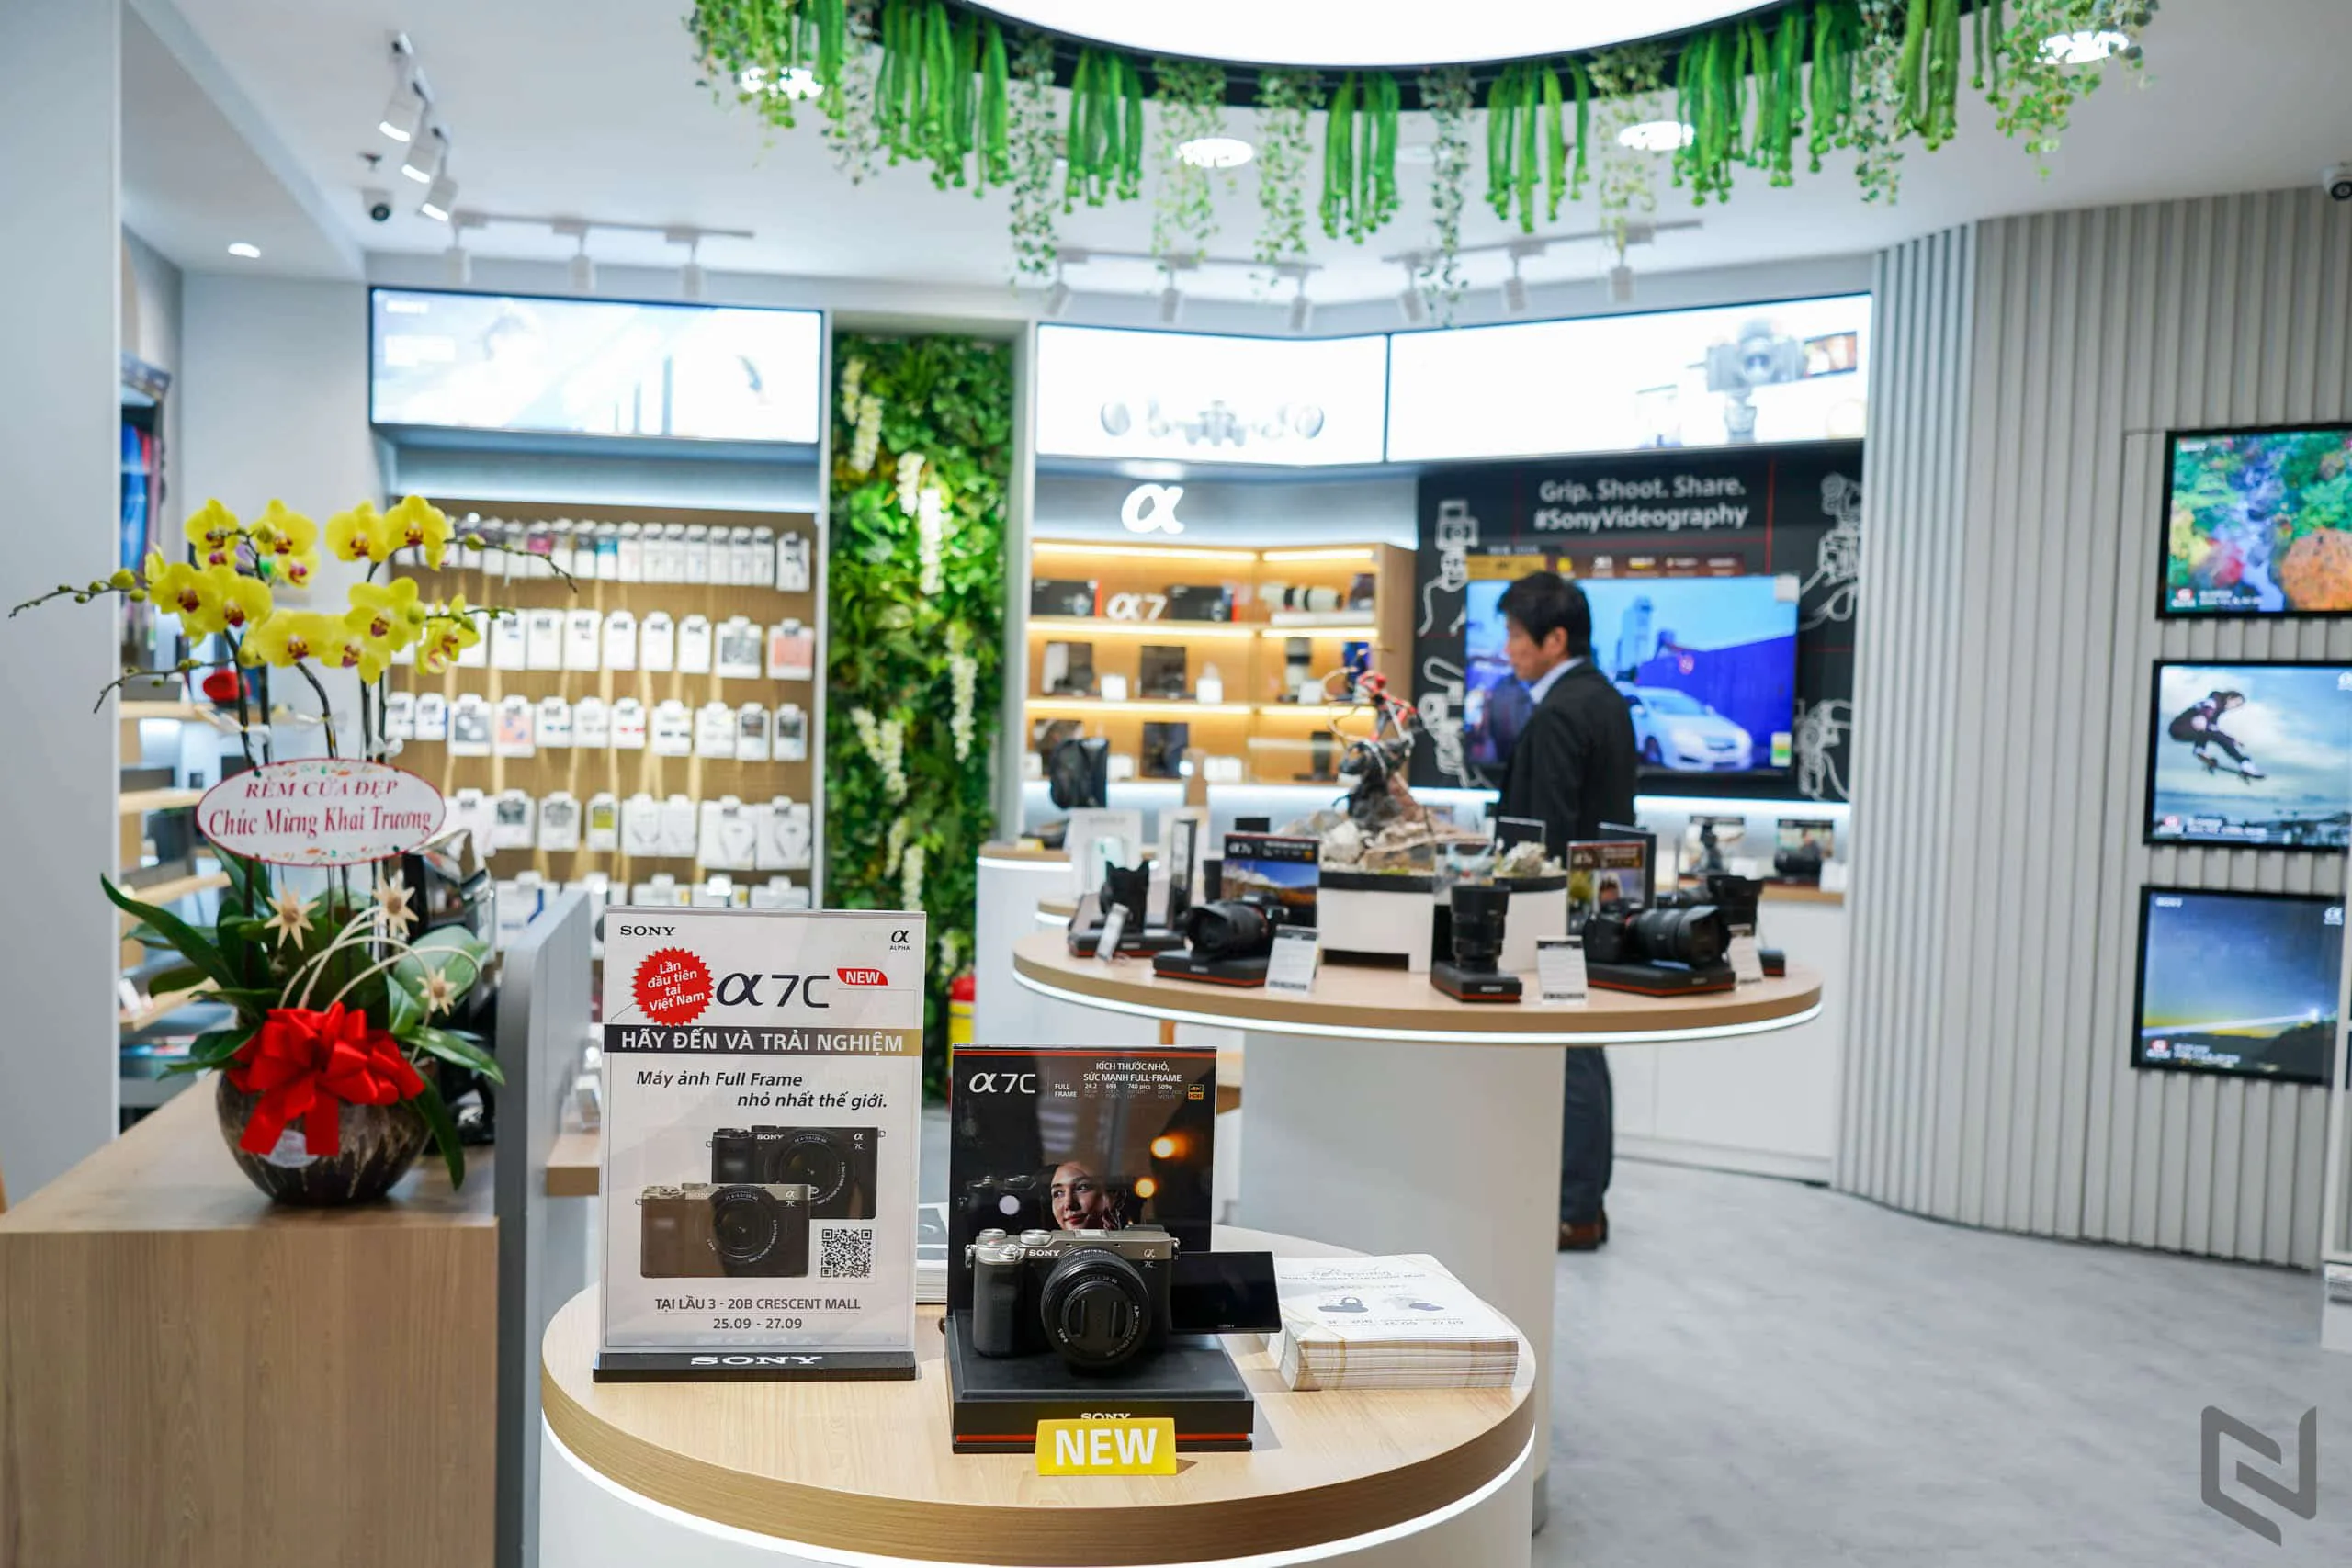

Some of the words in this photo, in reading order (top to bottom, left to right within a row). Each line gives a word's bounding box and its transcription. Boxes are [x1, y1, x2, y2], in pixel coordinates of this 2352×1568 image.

[1539, 479, 1592, 505] Grip.
[1596, 478, 1669, 501] Shoot.
[1673, 475, 1747, 499] Share.
[1533, 502, 1749, 534] #SonyVideography
[209, 808, 258, 836] Chúc
[324, 806, 365, 833] Khai
[620, 925, 675, 936] SONY
[659, 961, 681, 975] Lần
[647, 975, 671, 988] đầu
[673, 969, 697, 983] tiên
[845, 971, 880, 984] NEW
[665, 983, 681, 998] tại
[649, 998, 673, 1011] Việt
[676, 991, 705, 1006] Nam
[621, 1029, 665, 1050] HÃY
[673, 1027, 718, 1050] ĐẾN
[725, 1030, 754, 1050] VÀ
[761, 1030, 808, 1051] TRẢI
[817, 1032, 903, 1055] NGHIỆM
[1096, 1061, 1115, 1071] KÍCH
[1117, 1061, 1147, 1071] THƯỚC
[1148, 1062, 1169, 1072] NHỎ,
[636, 1071, 672, 1088] Máy
[678, 1070, 710, 1086] ảnh
[715, 1072, 746, 1086] Full
[750, 1073, 803, 1087] Frame
[1083, 1072, 1100, 1081] SỨC
[1102, 1074, 1128, 1084] MẠNH
[1130, 1074, 1182, 1082] FULL-FRAME
[737, 1092, 770, 1107] nhỏ
[775, 1090, 814, 1108] nhất
[819, 1090, 846, 1108] thế
[851, 1093, 888, 1111] giới.
[655, 1298, 675, 1314] TẠI
[679, 1295, 705, 1310] LẦU
[708, 1299, 716, 1309] 3
[728, 1299, 752, 1310] 20B
[756, 1299, 820, 1310] CRESCENT
[825, 1299, 861, 1310] MALL
[713, 1318, 751, 1329] 25.09
[766, 1318, 802, 1329] 27.09
[691, 1356, 823, 1365] SONY
[1056, 1429, 1158, 1465] NEW
